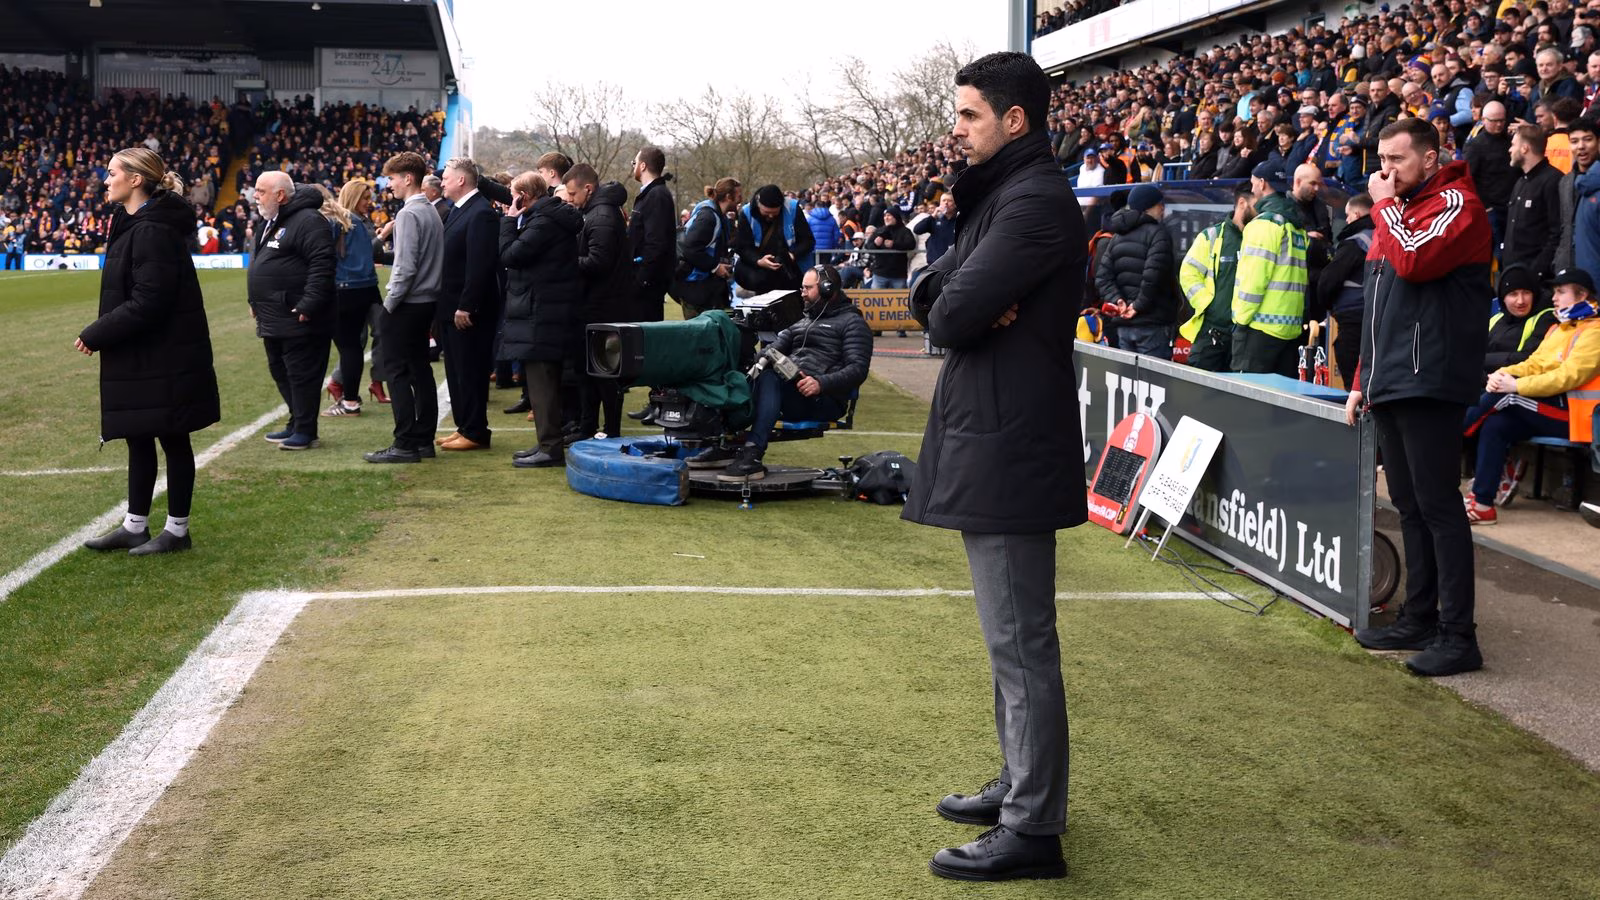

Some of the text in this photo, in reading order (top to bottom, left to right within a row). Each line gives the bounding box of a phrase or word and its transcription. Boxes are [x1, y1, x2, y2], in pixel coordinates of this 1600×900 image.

[334, 50, 380, 60] PREMIER
[863, 297, 894, 308] ONLY
[1189, 487, 1342, 594] ansfield) Ltd
